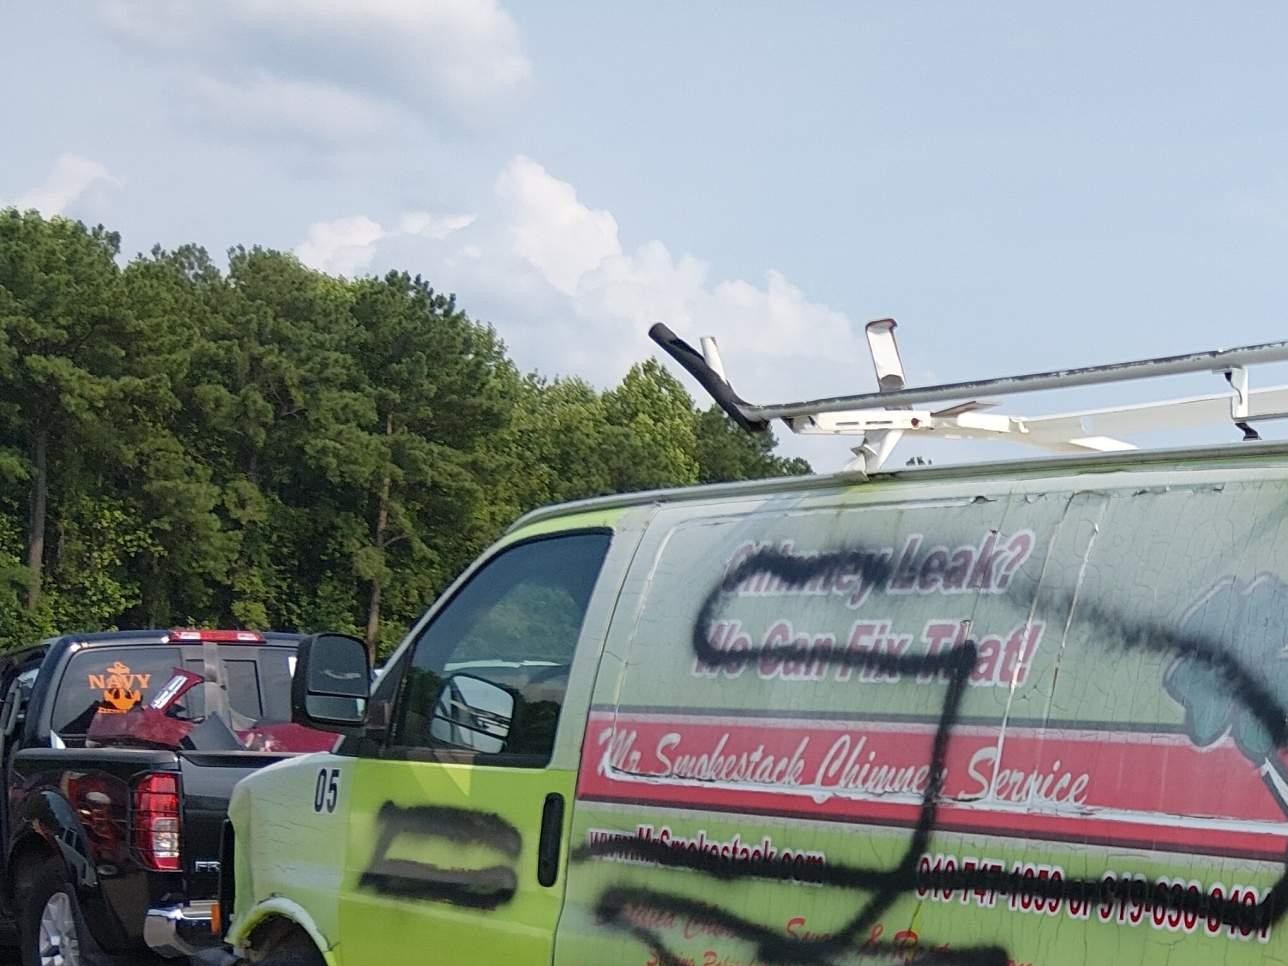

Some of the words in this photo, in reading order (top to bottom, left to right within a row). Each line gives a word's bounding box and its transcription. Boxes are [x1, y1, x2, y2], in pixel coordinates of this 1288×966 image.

[888, 528, 1036, 595] Leak?
[88, 672, 151, 690] NAVY
[757, 618, 836, 681] Can
[914, 619, 1048, 688] Tat!
[314, 767, 341, 815] 05
[597, 726, 643, 777] Mr
[655, 732, 811, 786] Smokestack
[958, 746, 1091, 808] Service
